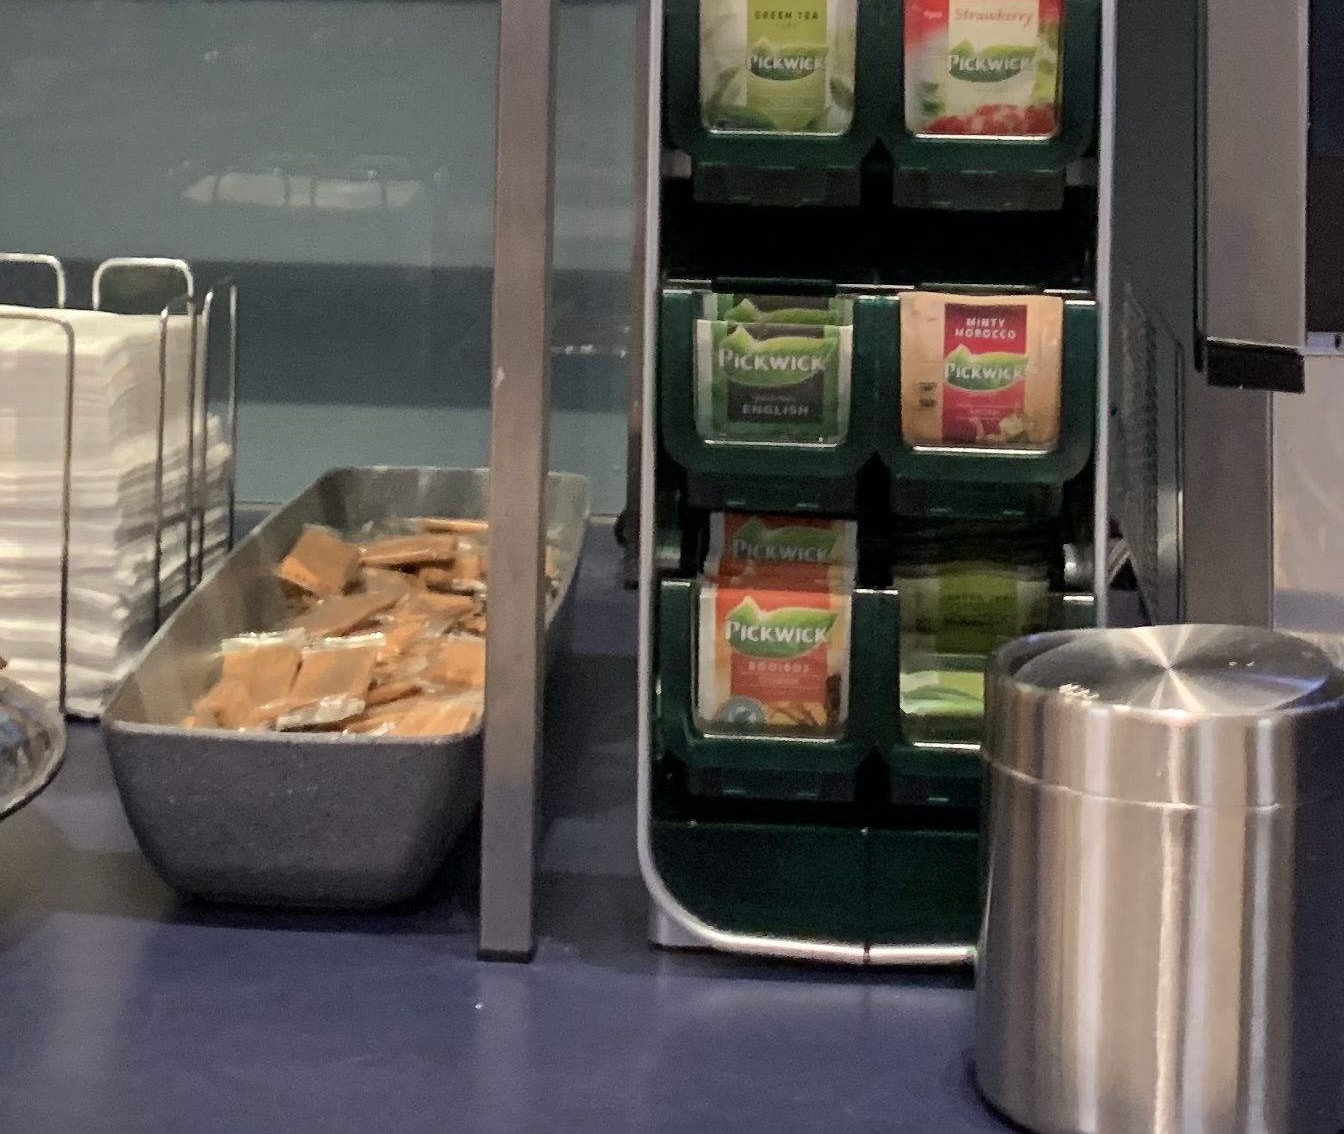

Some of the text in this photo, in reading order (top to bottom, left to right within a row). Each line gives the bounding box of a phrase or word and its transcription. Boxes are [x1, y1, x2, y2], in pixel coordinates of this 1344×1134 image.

[754, 10, 820, 21] GREEN TEA
[953, 8, 1035, 33] Strawberry
[965, 317, 1007, 329] MINTY
[954, 328, 1017, 341] MOROCCO
[718, 348, 828, 373] PICKWICK
[943, 362, 1026, 381] PICKWICK
[742, 403, 810, 417] ENGLISH
[724, 620, 830, 644] PICKWICK
